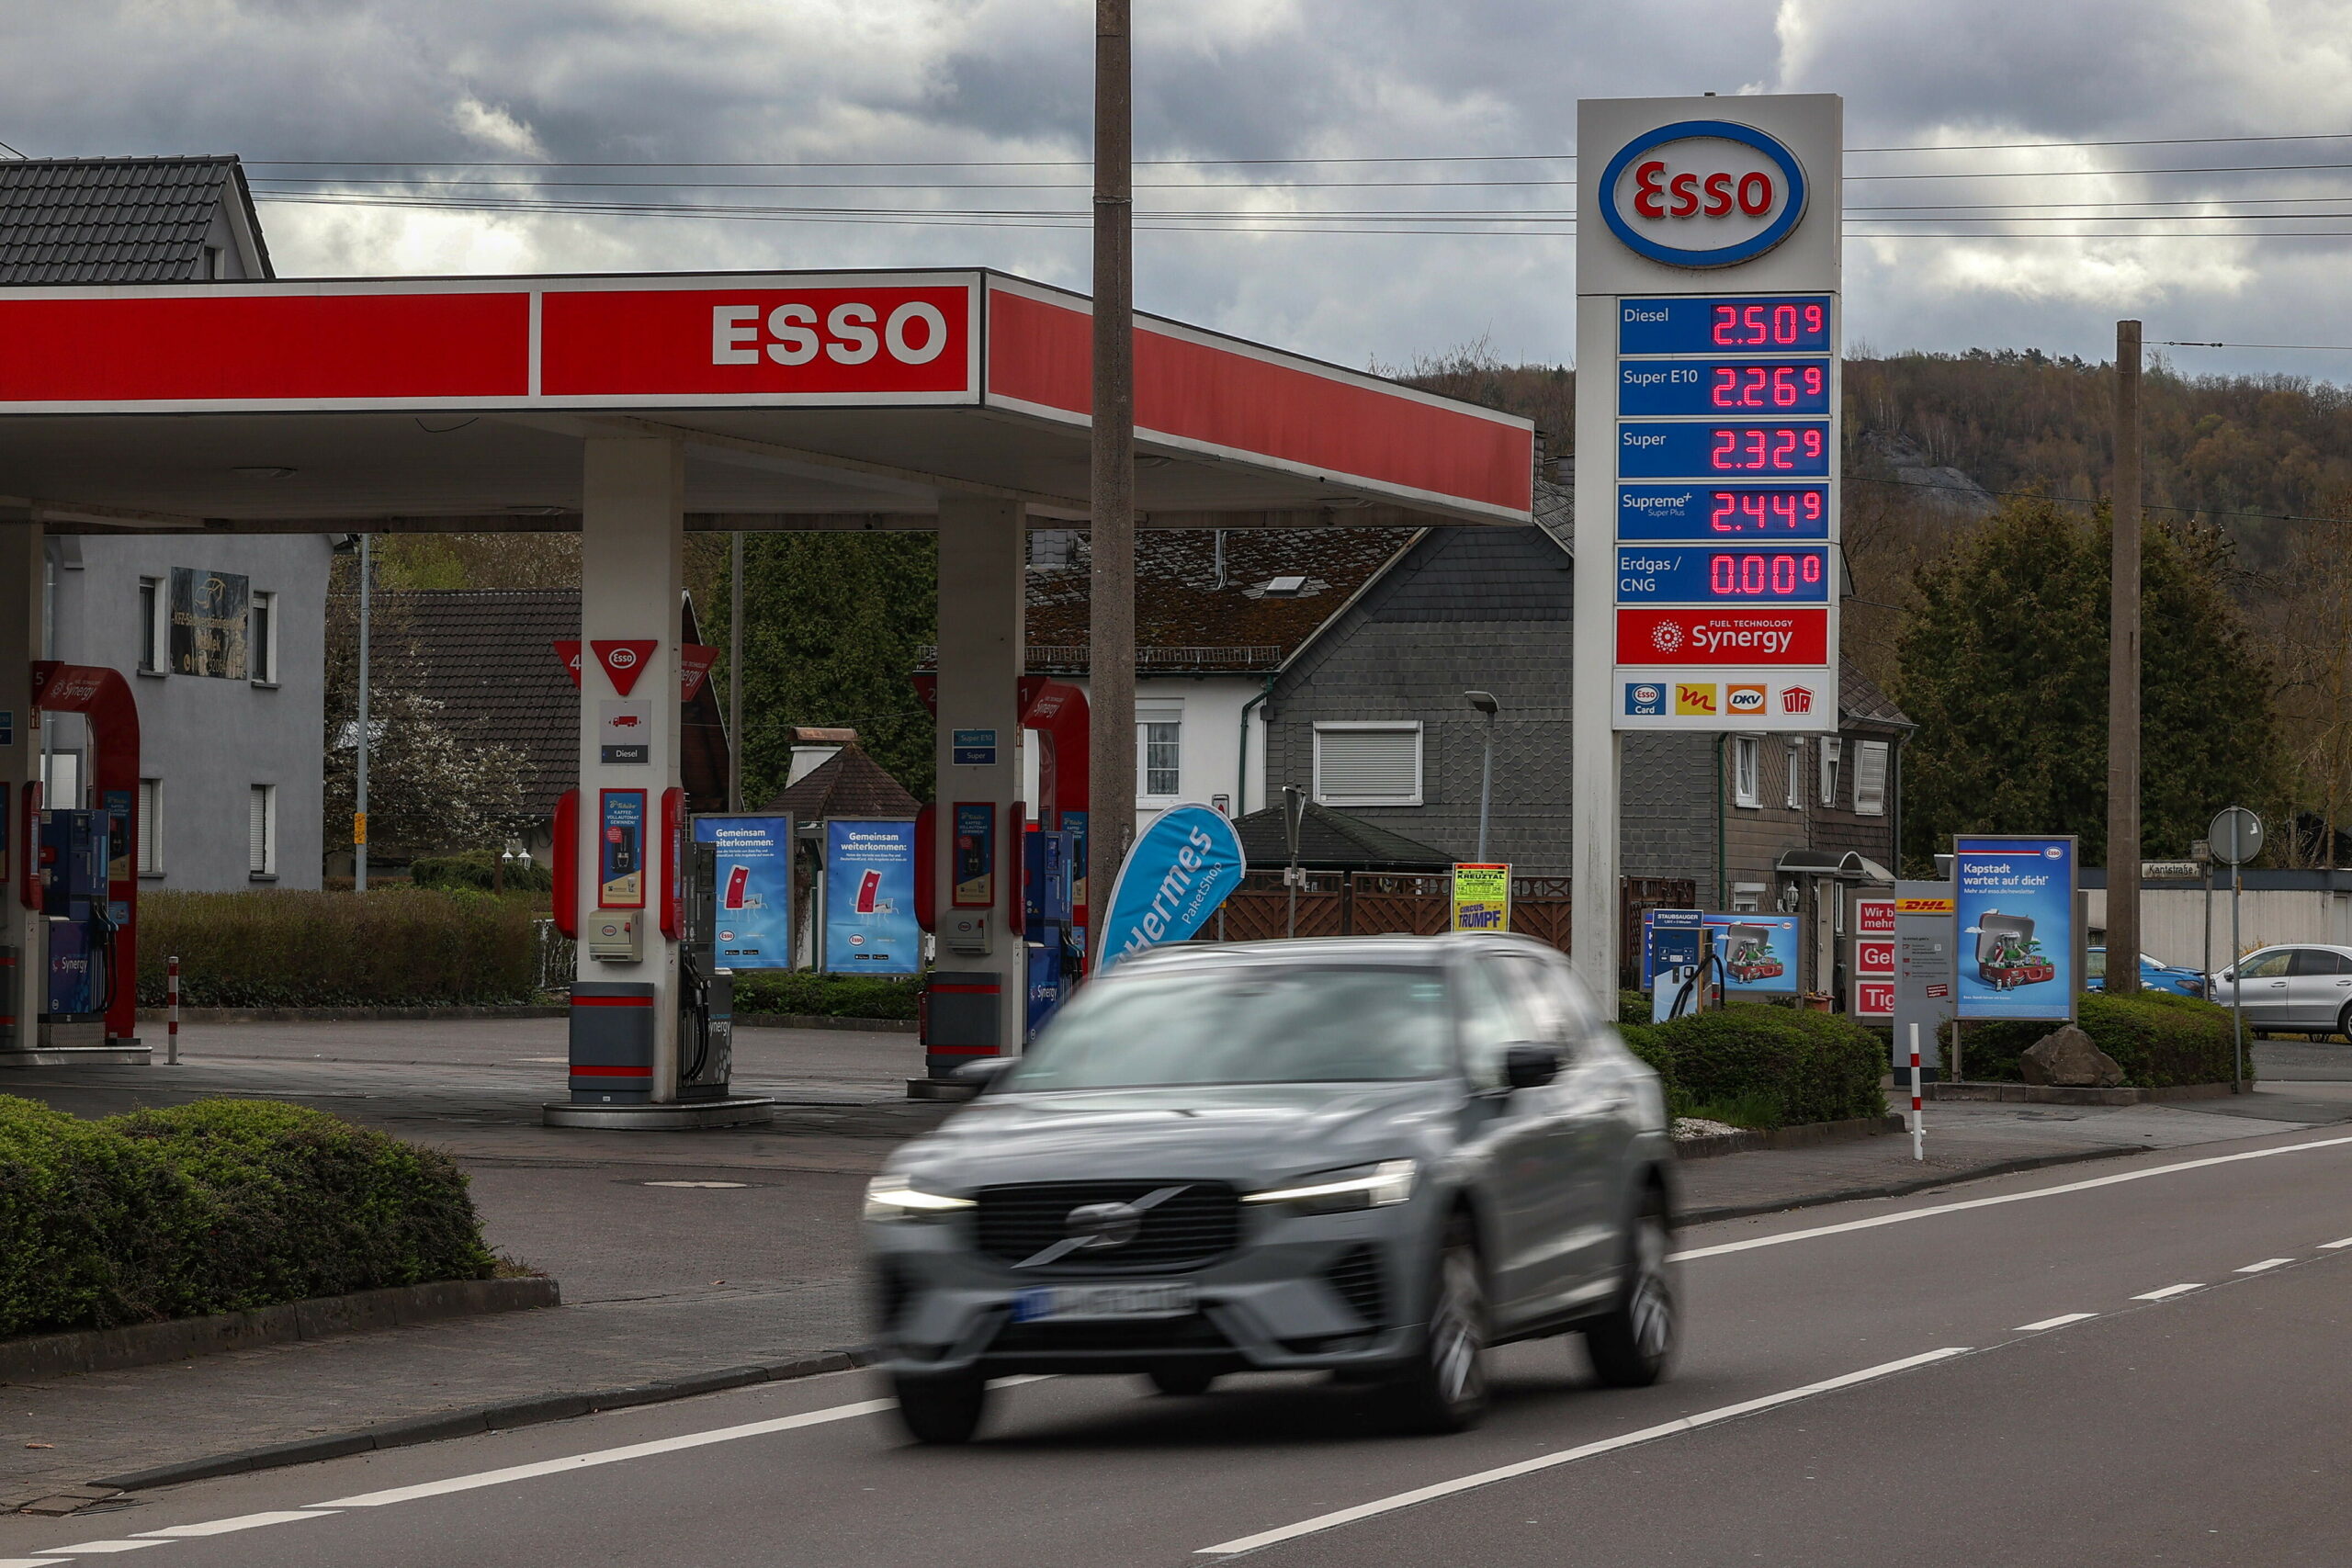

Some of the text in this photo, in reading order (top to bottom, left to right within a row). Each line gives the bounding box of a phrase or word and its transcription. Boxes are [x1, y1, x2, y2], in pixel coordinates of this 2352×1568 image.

[1634, 161, 1772, 218] Esso
[1623, 305, 1822, 344] Diesel 2.509
[712, 301, 947, 366] ESSO
[1623, 367, 1822, 407] Super E10 2.269
[1623, 430, 1822, 469] Super 2.329
[1648, 509, 1668, 517] Super
[1712, 491, 1821, 531] 2.449
[1621, 557, 1671, 574] Erdgas
[1712, 554, 1821, 594] 0.000
[1621, 579, 1656, 592] CNG
[1692, 626, 1793, 653] Synergy
[570, 654, 582, 670] 4
[613, 653, 633, 662] Esso
[36, 671, 44, 685] 5
[63, 682, 96, 701] Synergy
[928, 689, 936, 702] 2
[1021, 689, 1028, 702] 1
[1732, 695, 1761, 705] DKV
[1782, 685, 1812, 713] UTA
[1635, 705, 1655, 714] Card
[616, 750, 638, 758] Diesel
[967, 751, 986, 760] Super
[716, 828, 765, 838] Gemeinsam
[849, 832, 899, 840] Gemeinsam
[707, 838, 774, 847] eiterkommen:
[841, 841, 907, 851] weiterkommen:
[1963, 863, 2011, 875] Kapstadt
[2149, 864, 2193, 875] Kantstraße
[1963, 876, 2001, 886] wartet
[2002, 875, 2019, 886] auf
[1182, 862, 1223, 925] PaketShop
[1459, 903, 1485, 913] CIRCUS
[1905, 900, 1948, 910] DHL
[1458, 909, 1501, 928] TRUMPF
[1864, 908, 1883, 917] Wir
[62, 956, 88, 974] Synergy
[1037, 984, 1057, 1001] Synergy
